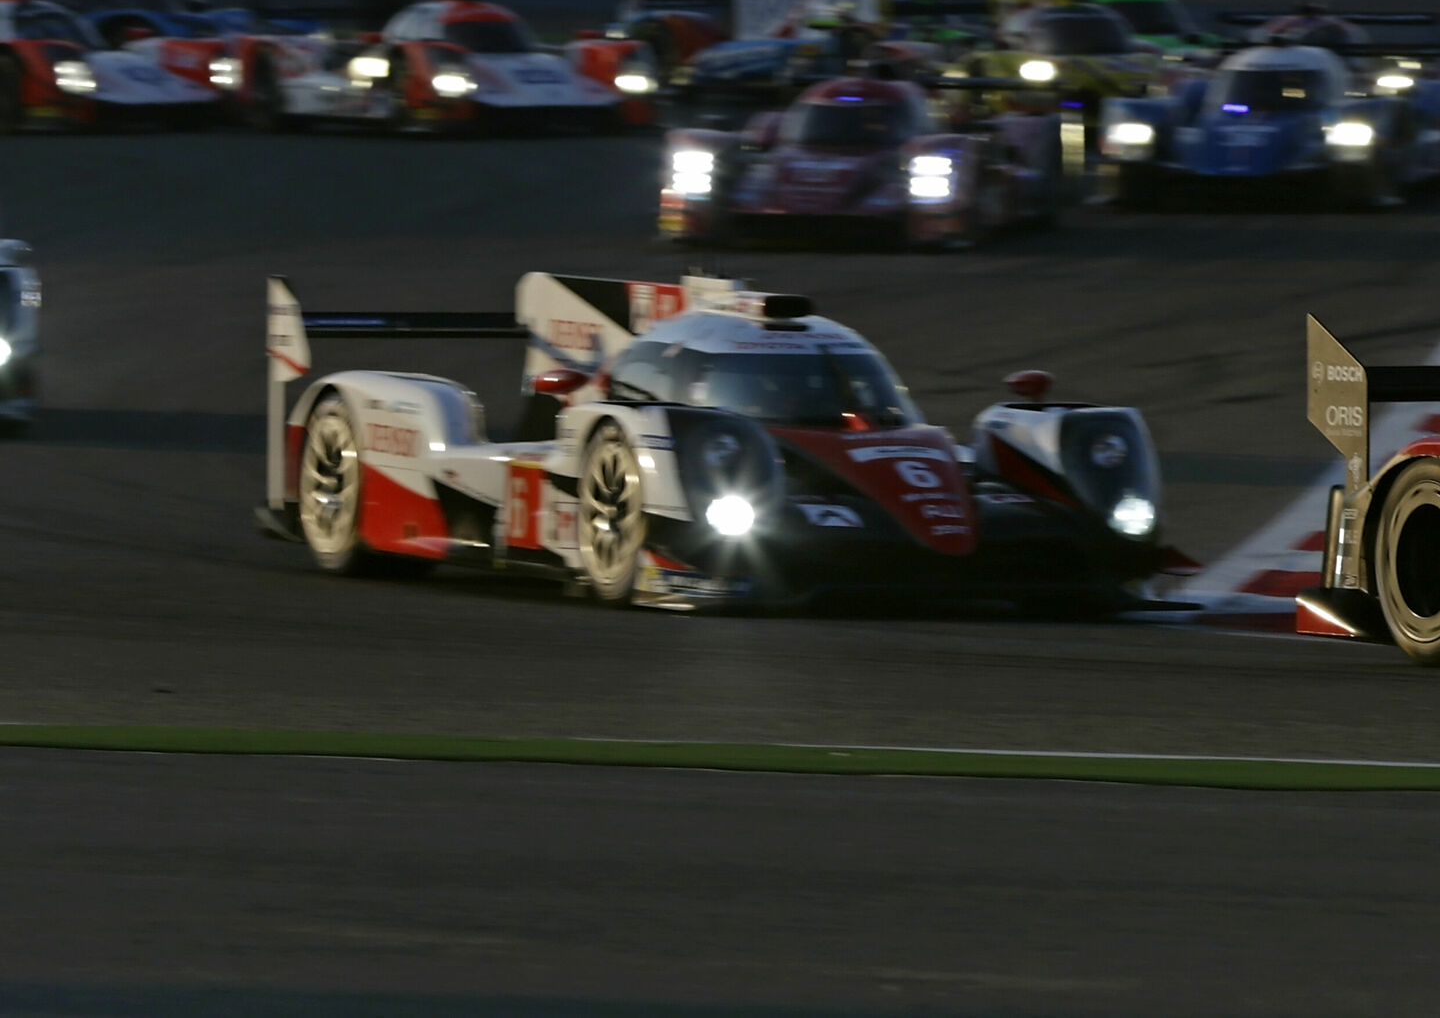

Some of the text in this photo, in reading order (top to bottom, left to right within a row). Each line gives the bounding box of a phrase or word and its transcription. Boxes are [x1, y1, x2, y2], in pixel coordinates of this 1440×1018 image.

[1326, 365, 1363, 382] BOSCH
[1326, 405, 1363, 426] ORIS
[893, 460, 943, 488] 6
